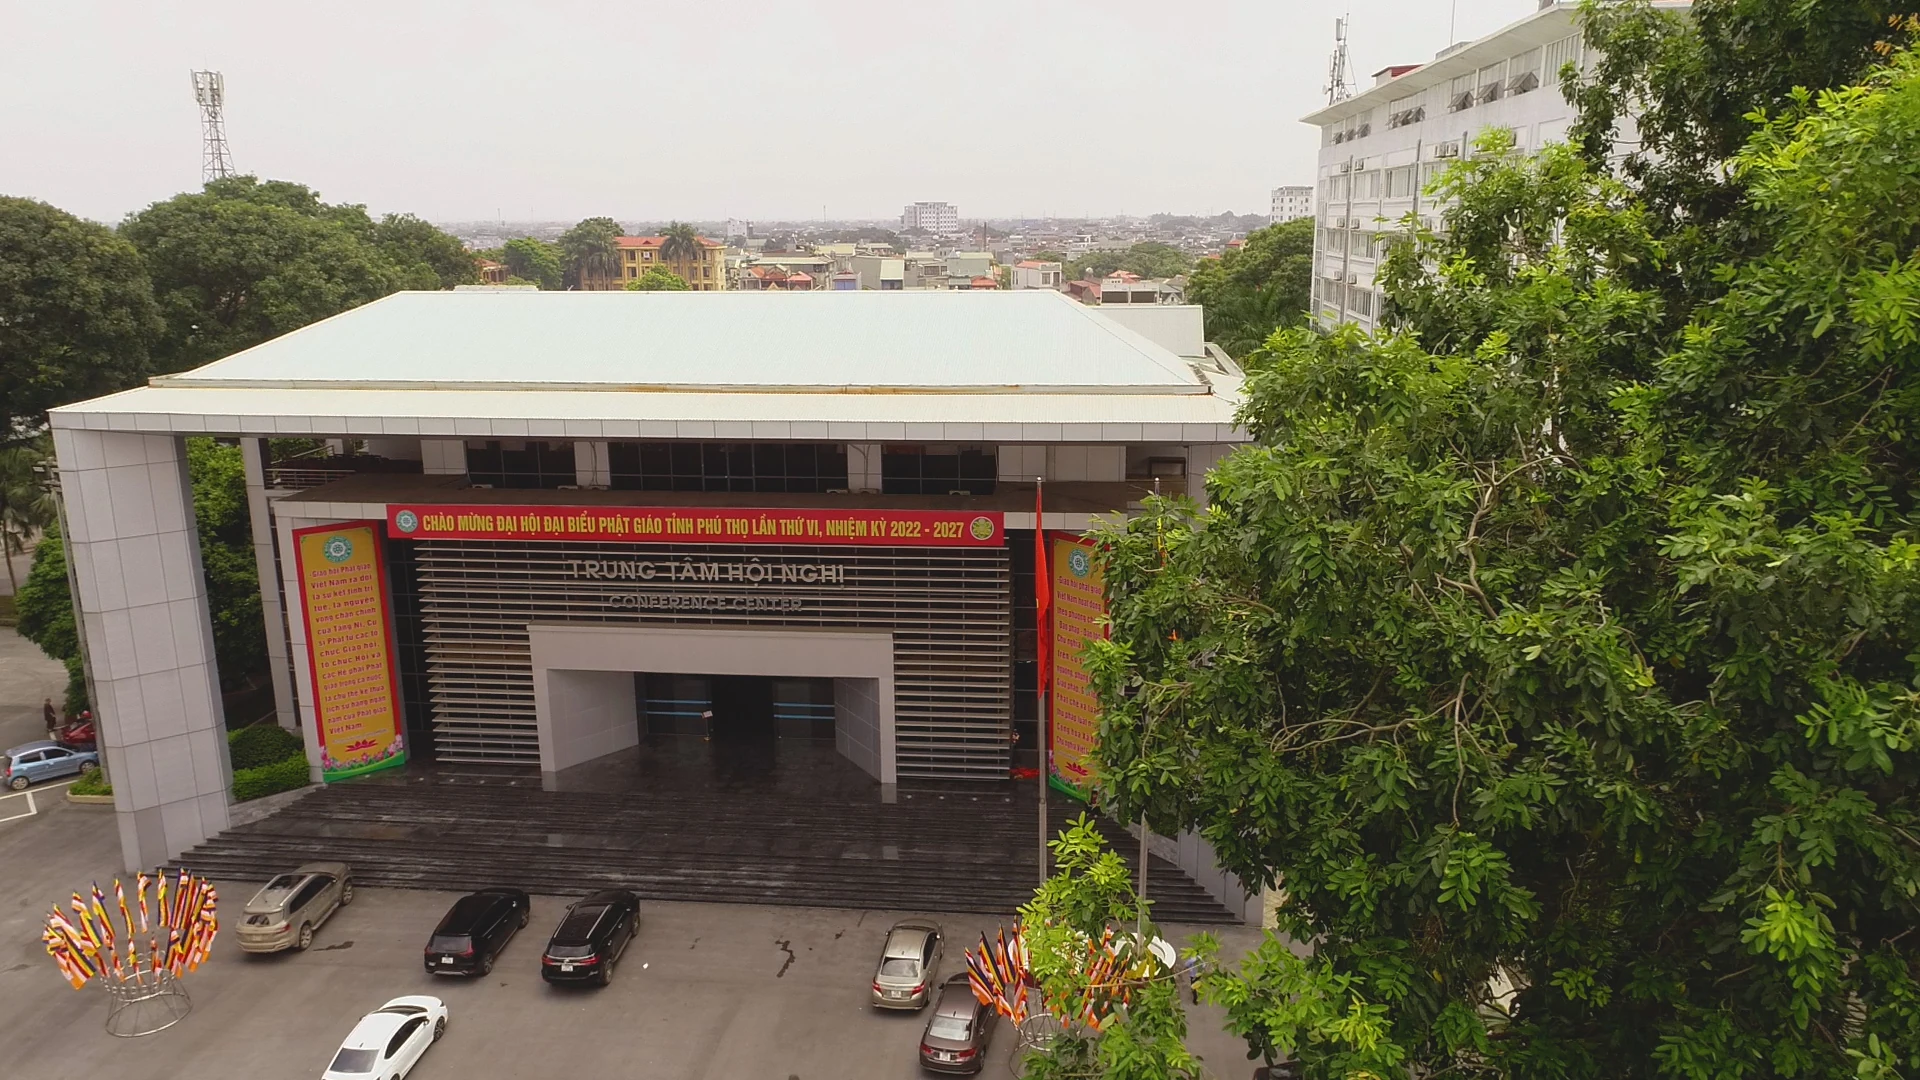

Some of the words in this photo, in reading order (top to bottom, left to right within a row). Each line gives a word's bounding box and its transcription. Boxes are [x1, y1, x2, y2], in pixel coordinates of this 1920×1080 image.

[423, 512, 454, 532] CHÀO
[458, 512, 494, 532] MỪNG
[497, 516, 517, 535] ĐẠI
[520, 513, 540, 535] HỘI
[544, 516, 564, 536] ĐẠI
[568, 510, 595, 532] BIỂU
[599, 514, 630, 536] PHẬT
[634, 514, 662, 534] GIÁO
[665, 512, 693, 534] TỈNH
[697, 515, 721, 534] PHÚ
[725, 519, 748, 538] THỌ
[752, 514, 776, 535] LẦN
[780, 516, 804, 536] THỨ
[806, 520, 822, 537] VI,
[826, 517, 867, 539] NHIỆM
[871, 517, 887, 536] KỲ
[890, 521, 921, 537] 2022
[934, 522, 964, 538] 2027
[329, 578, 347, 586] Nam
[568, 560, 656, 579] TRUNG
[666, 557, 718, 581] TÂM
[728, 558, 772, 587] HỘI
[782, 564, 844, 589] NGHỊ
[609, 595, 726, 610] CONFERENCE
[733, 597, 802, 611] CENTER
